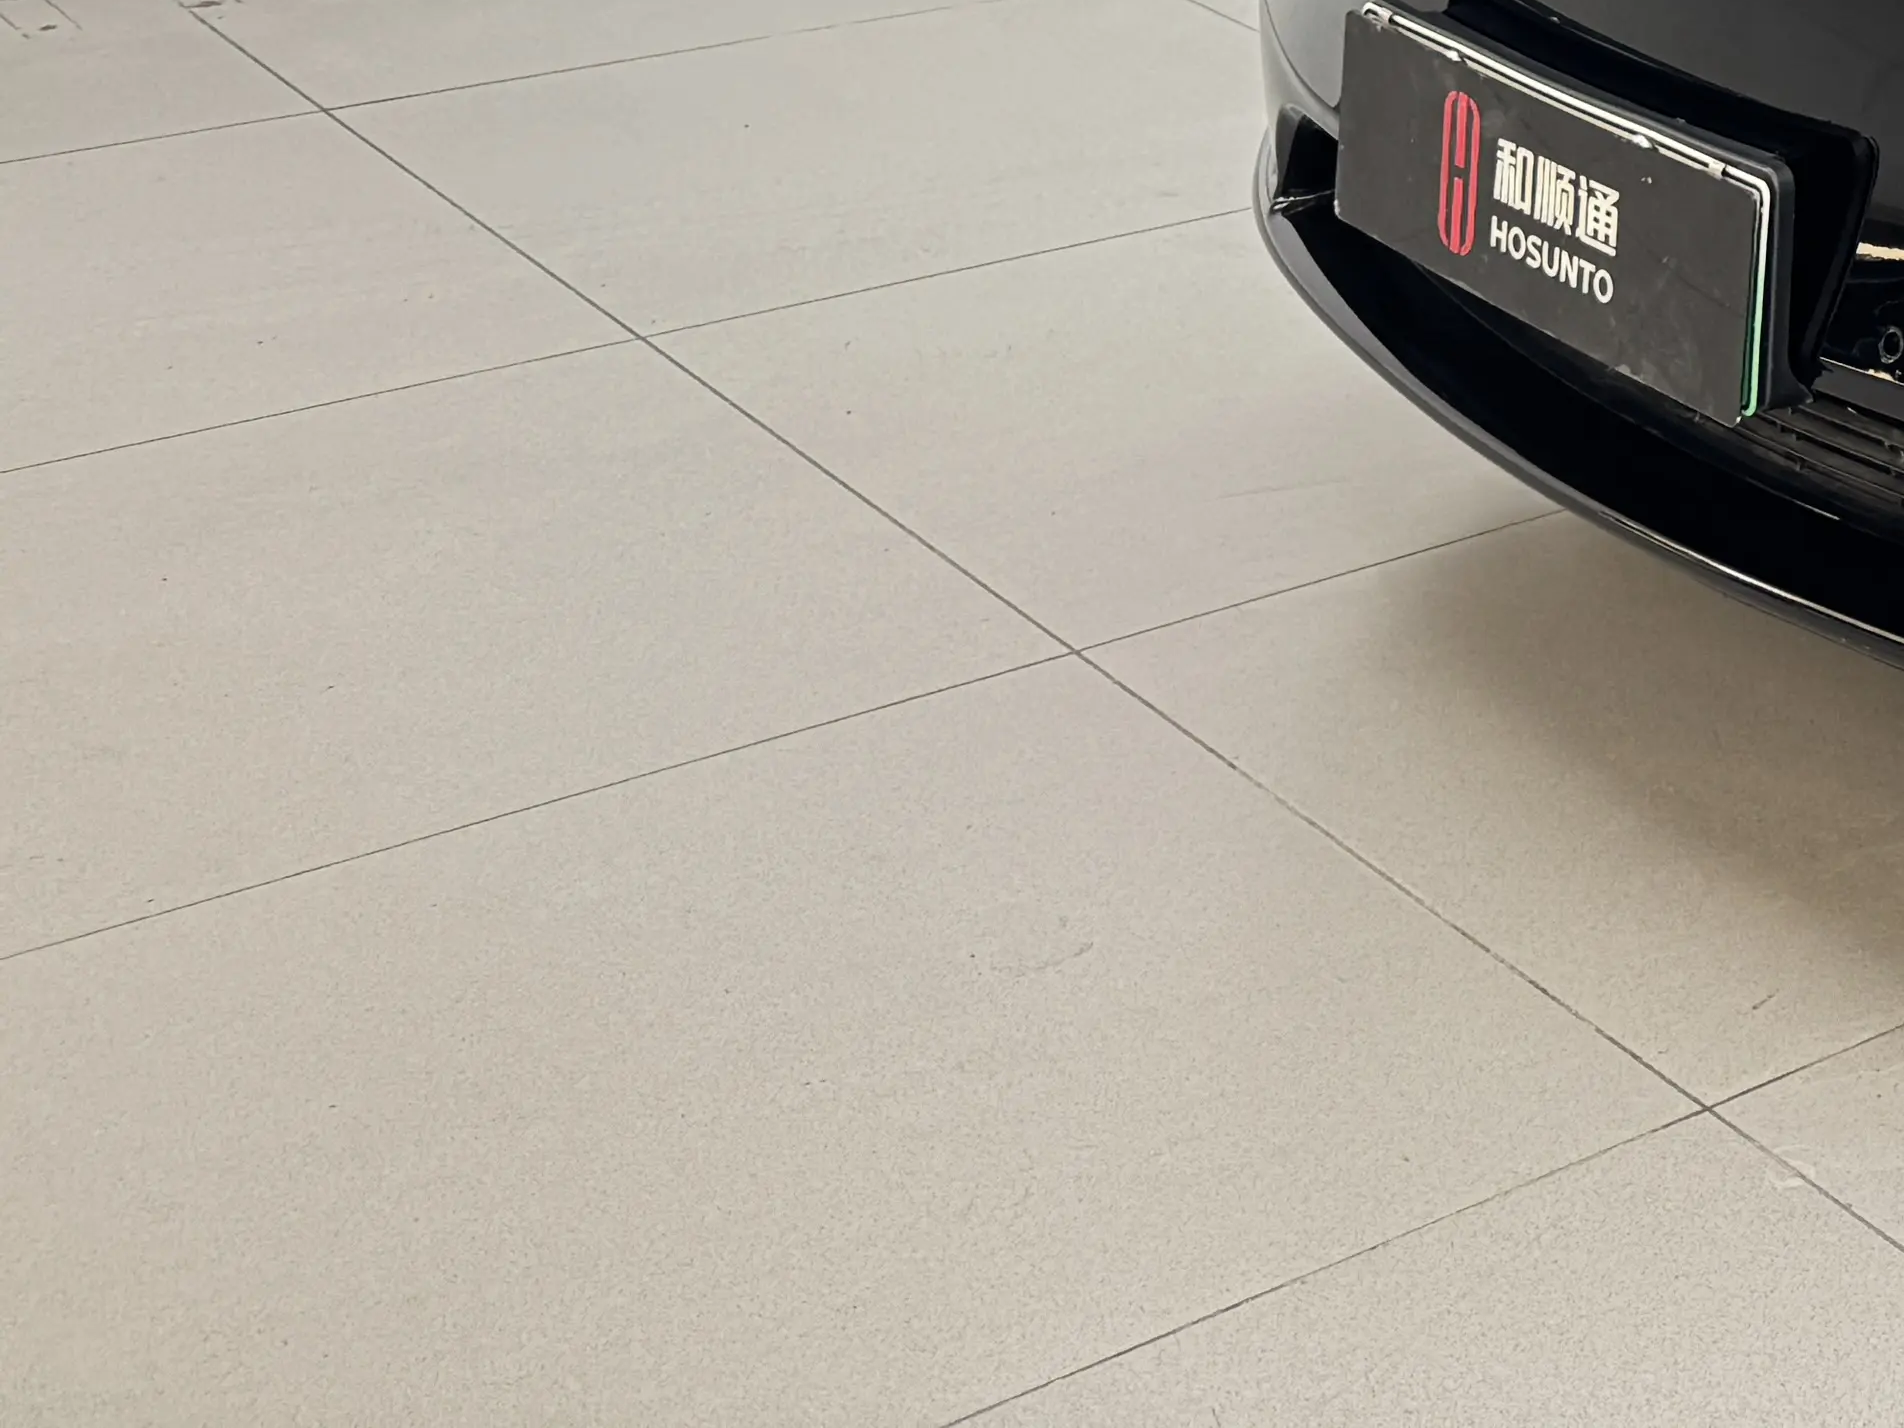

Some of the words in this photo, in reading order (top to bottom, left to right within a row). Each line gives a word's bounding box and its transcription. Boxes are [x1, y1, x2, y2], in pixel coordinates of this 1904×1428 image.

[1493, 137, 1620, 256] 和顺通
[1490, 215, 1614, 304] HOSUNTO
